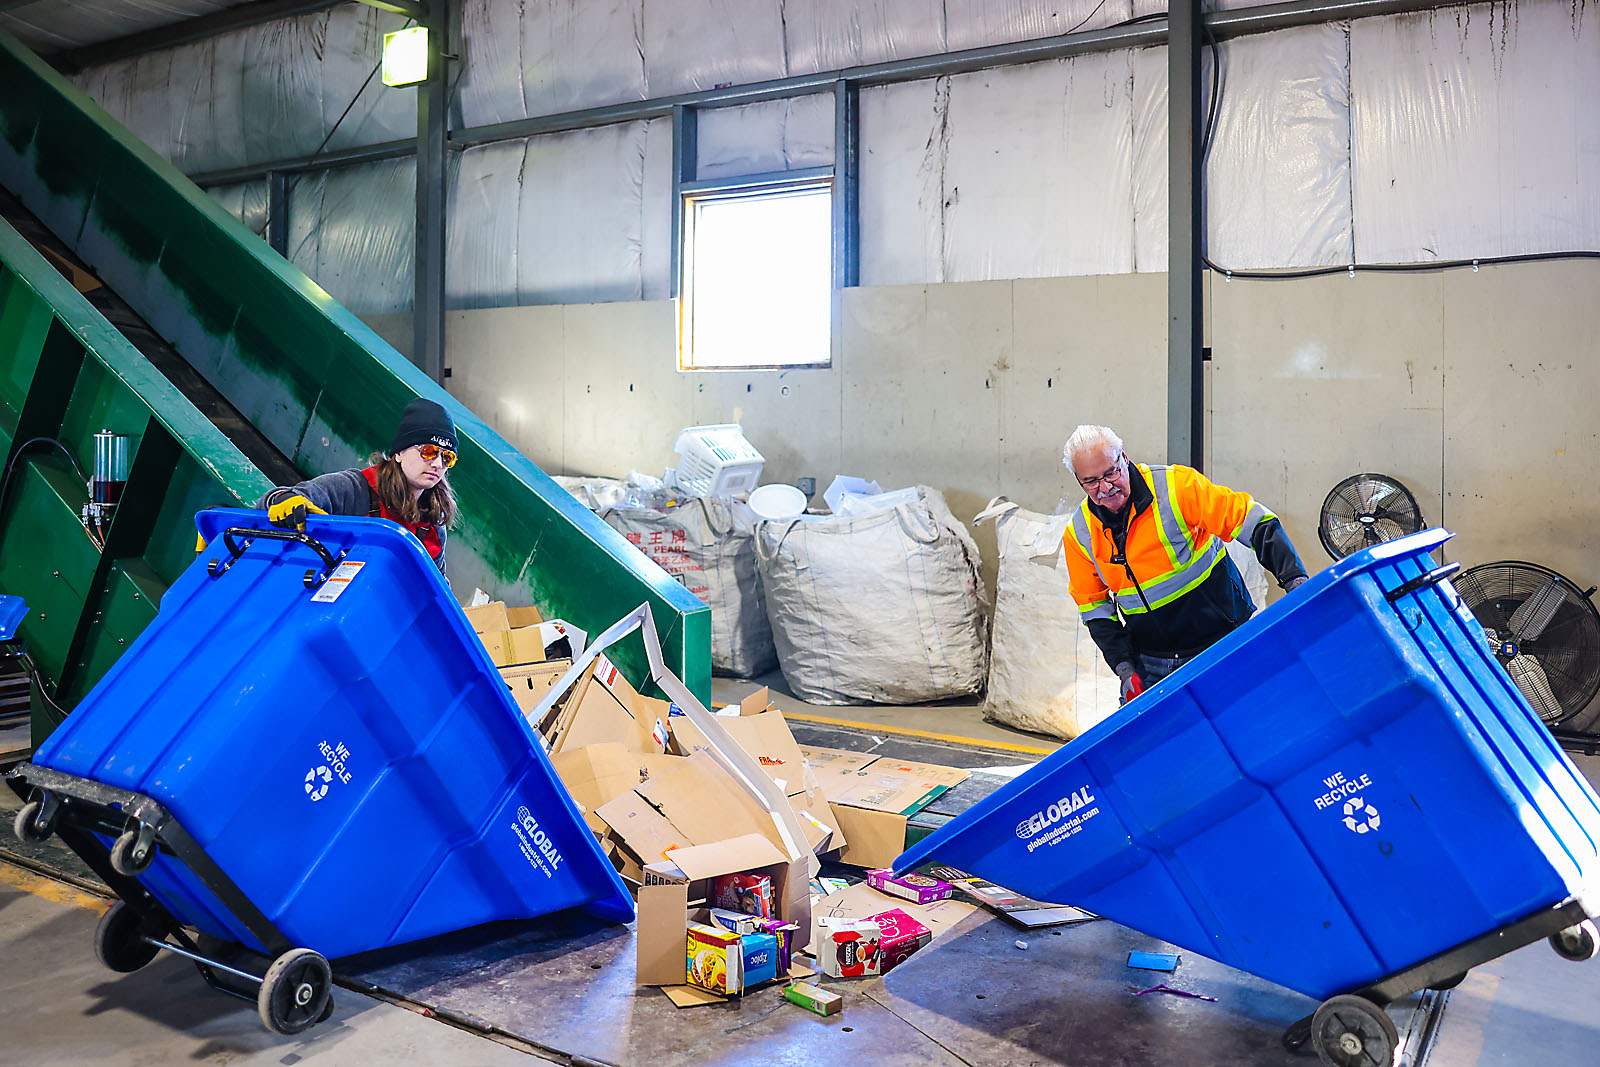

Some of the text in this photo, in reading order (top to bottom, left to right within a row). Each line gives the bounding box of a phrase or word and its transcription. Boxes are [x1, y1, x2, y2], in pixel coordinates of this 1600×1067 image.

[654, 545, 688, 554] PEARL
[317, 740, 353, 784] RECYCLE
[335, 741, 351, 762] WE
[1313, 773, 1373, 810] RECYCLE
[1323, 771, 1347, 789] WE
[1027, 807, 1100, 853] globalindustrial.com
[1029, 786, 1095, 834] GLOBAL
[510, 822, 552, 879] globalindustrial.com
[523, 815, 562, 871] GLOBAL
